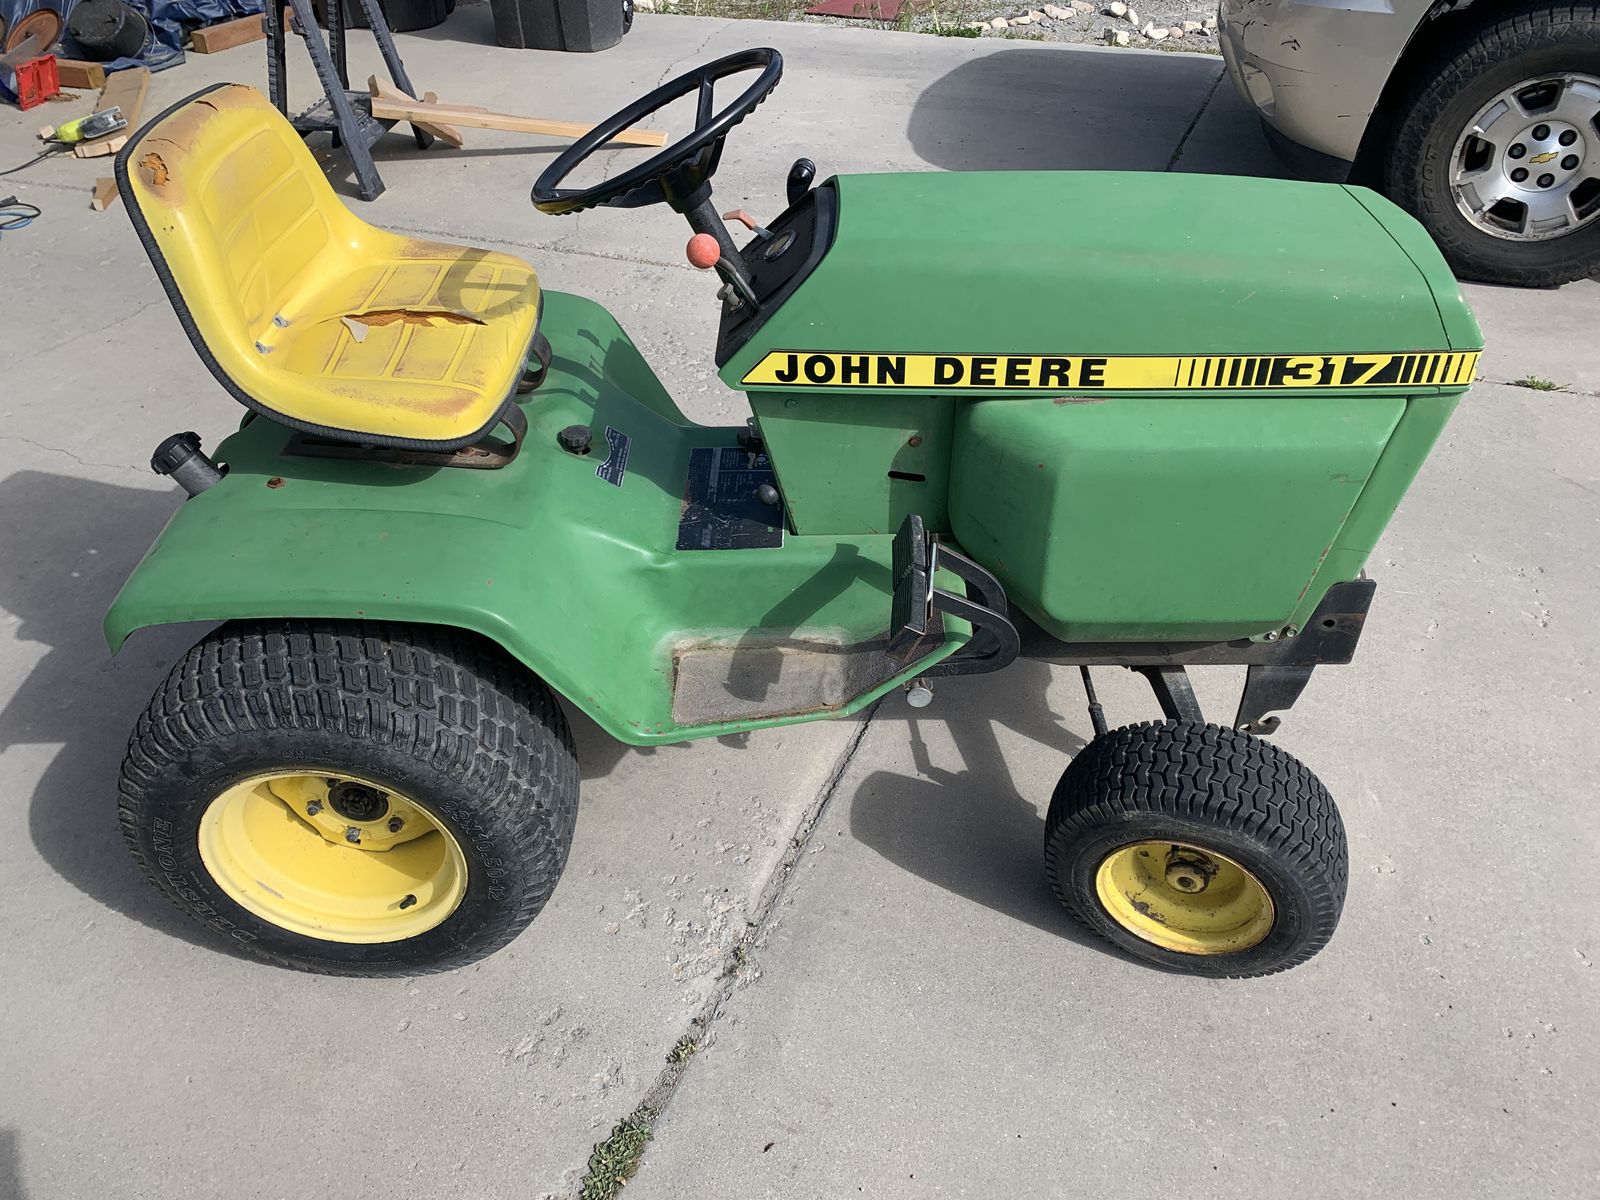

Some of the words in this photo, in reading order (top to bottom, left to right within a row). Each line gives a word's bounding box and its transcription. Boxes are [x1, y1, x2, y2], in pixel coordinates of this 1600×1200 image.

[1422, 143, 1441, 214] FOOT
[775, 354, 905, 385] JOHN
[934, 357, 1107, 387] DEERE
[1282, 356, 1393, 386] 317
[153, 817, 257, 944] DEESTONE
